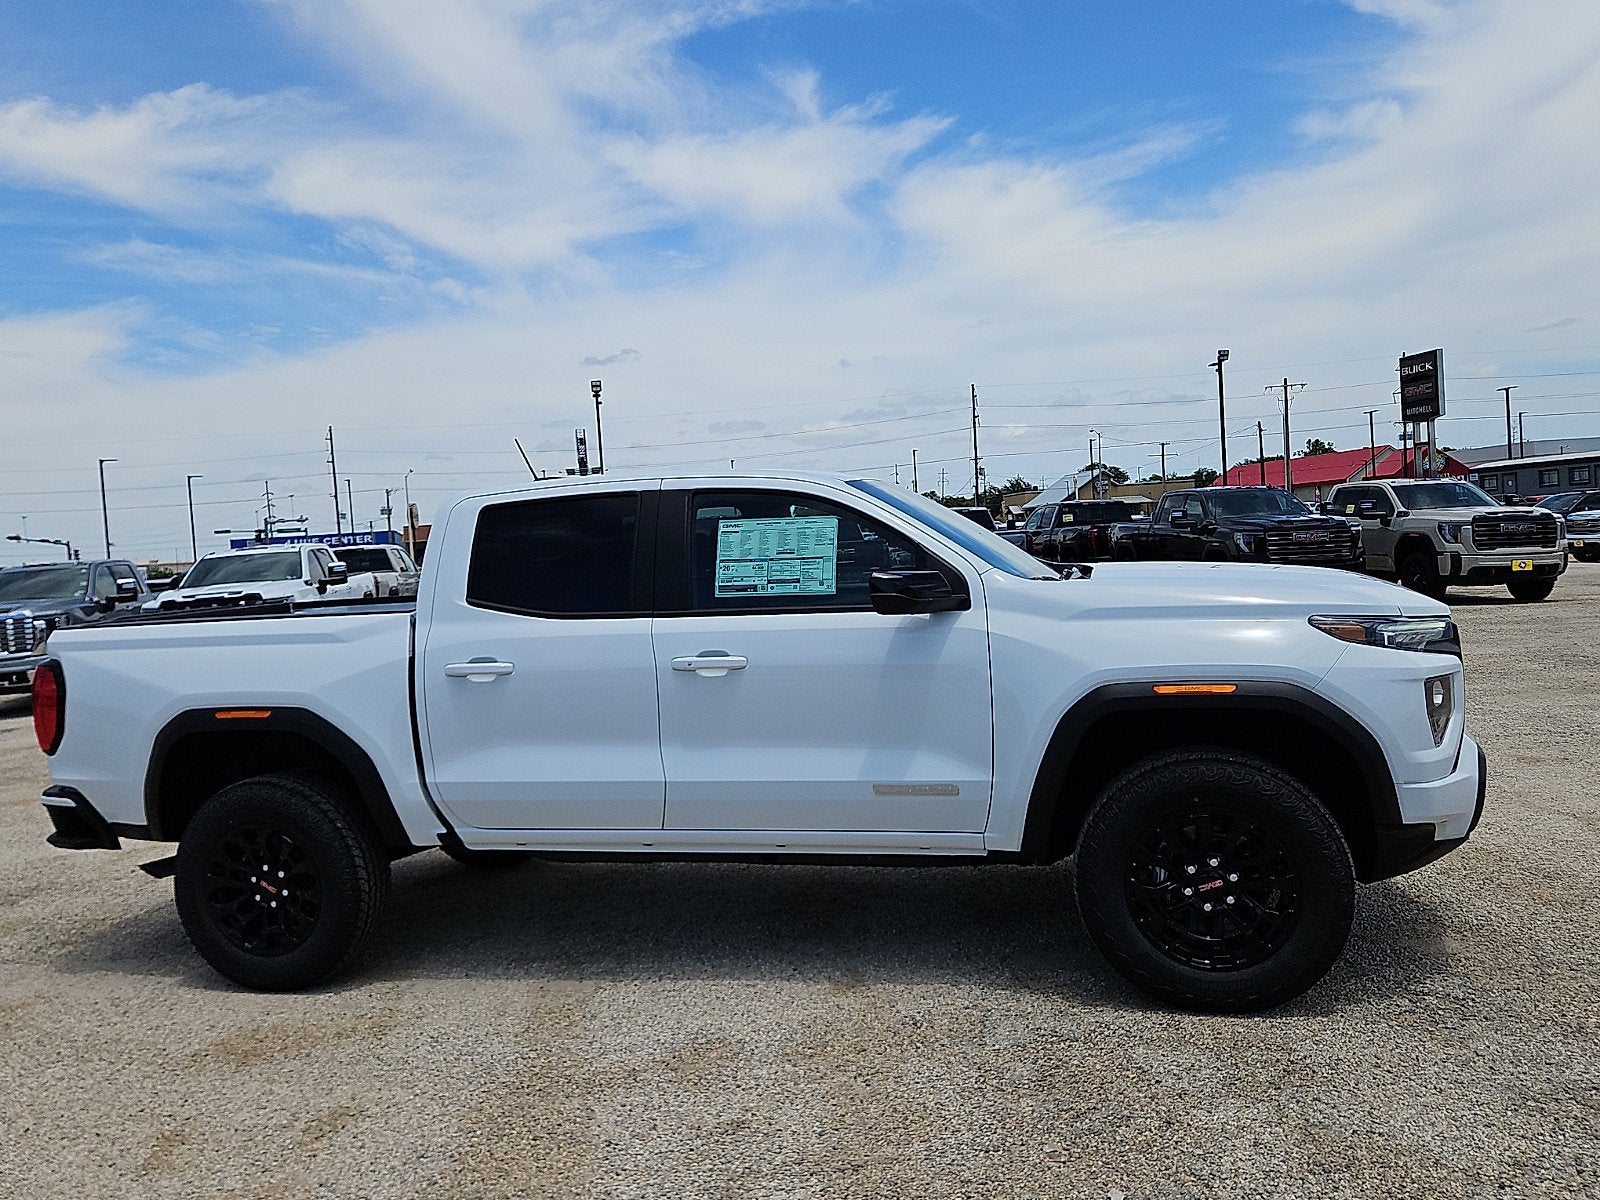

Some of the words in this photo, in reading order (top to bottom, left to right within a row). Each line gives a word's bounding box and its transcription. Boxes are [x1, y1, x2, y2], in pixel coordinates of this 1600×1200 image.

[1401, 361, 1433, 376] BUICK
[1404, 382, 1433, 396] GMC
[1406, 404, 1433, 416] MITCHELL
[323, 535, 373, 545] CENTER
